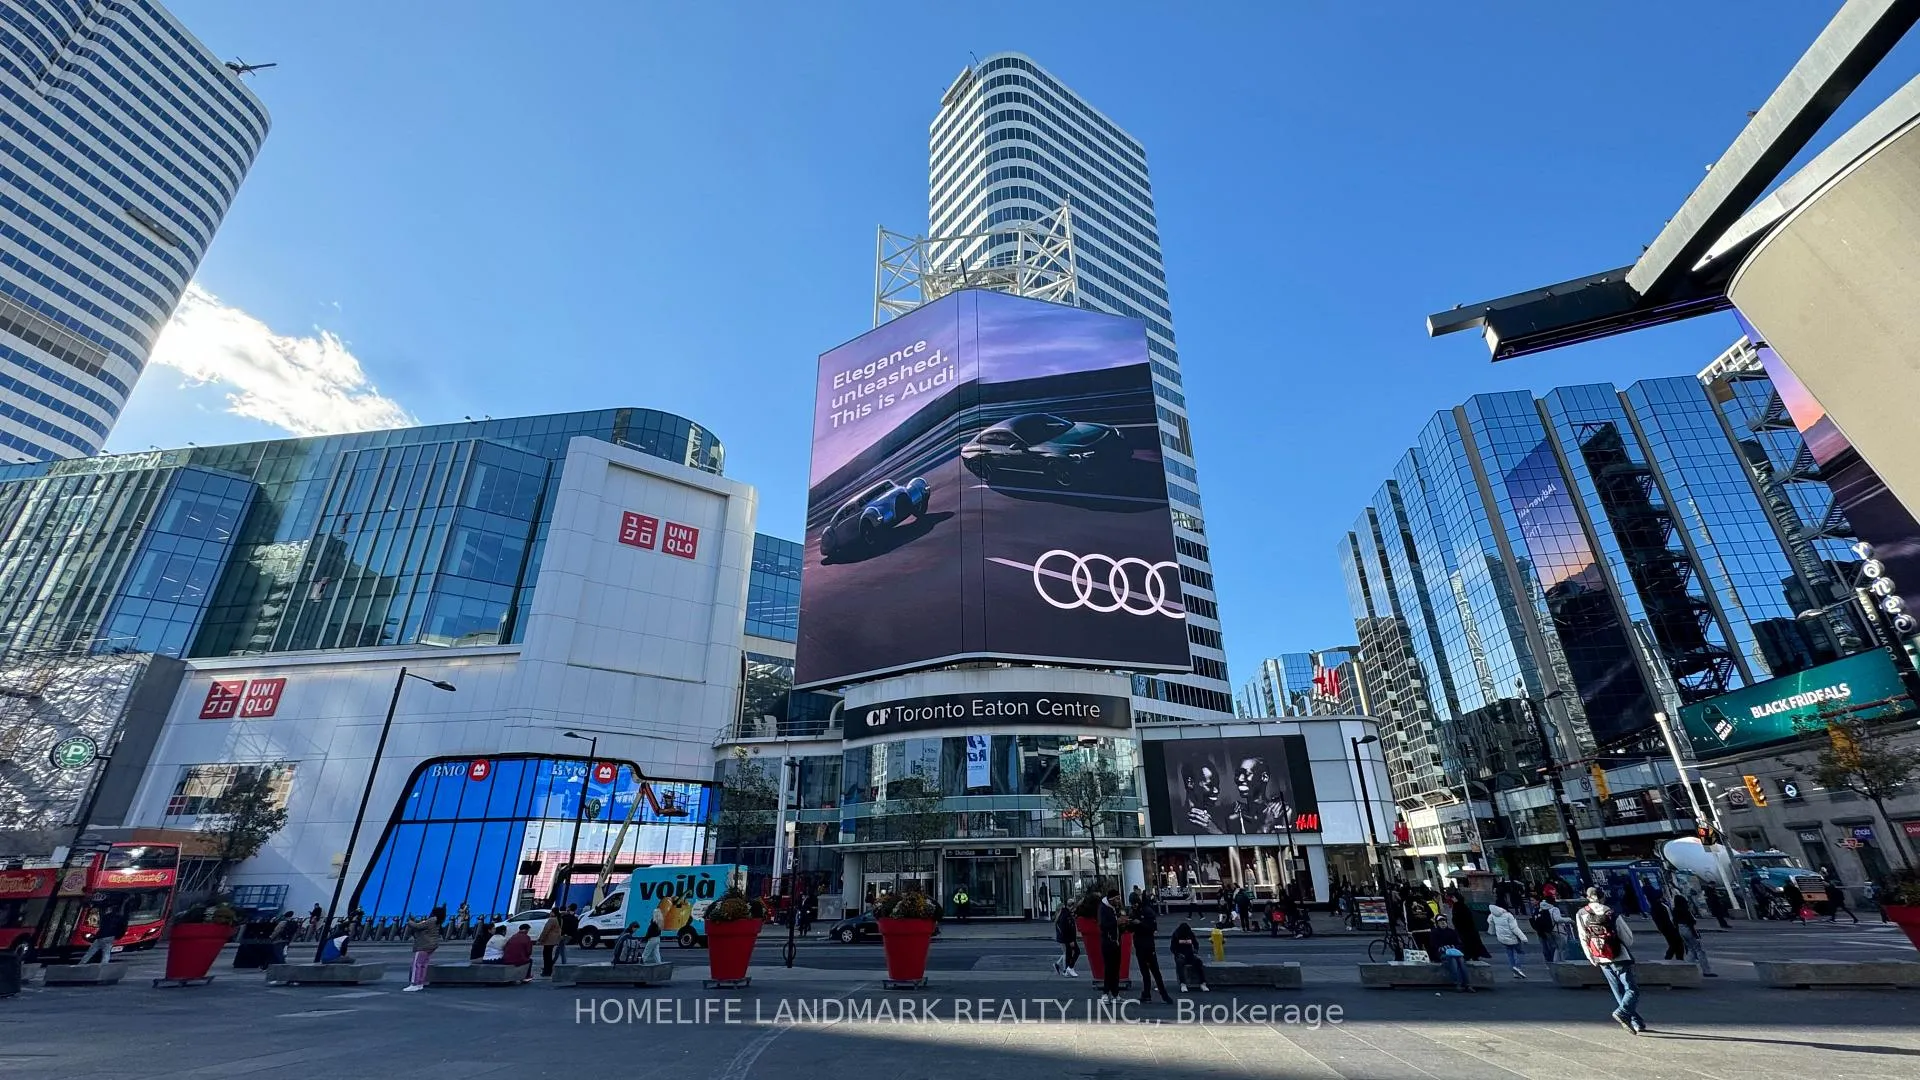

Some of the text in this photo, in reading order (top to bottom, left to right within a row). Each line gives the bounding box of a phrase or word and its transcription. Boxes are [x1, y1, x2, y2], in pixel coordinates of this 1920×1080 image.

[833, 340, 927, 390] Elegance
[831, 349, 948, 409] unleashed.
[830, 365, 954, 428] This is Audi
[866, 698, 1101, 727] CF Toronto Eaton Centre
[1750, 698, 1791, 719] BLACK
[66, 744, 85, 758] P
[432, 764, 466, 777] BMO
[1615, 797, 1637, 811] MUJI
[1295, 813, 1318, 831] H&M
[640, 872, 716, 901] voilà
